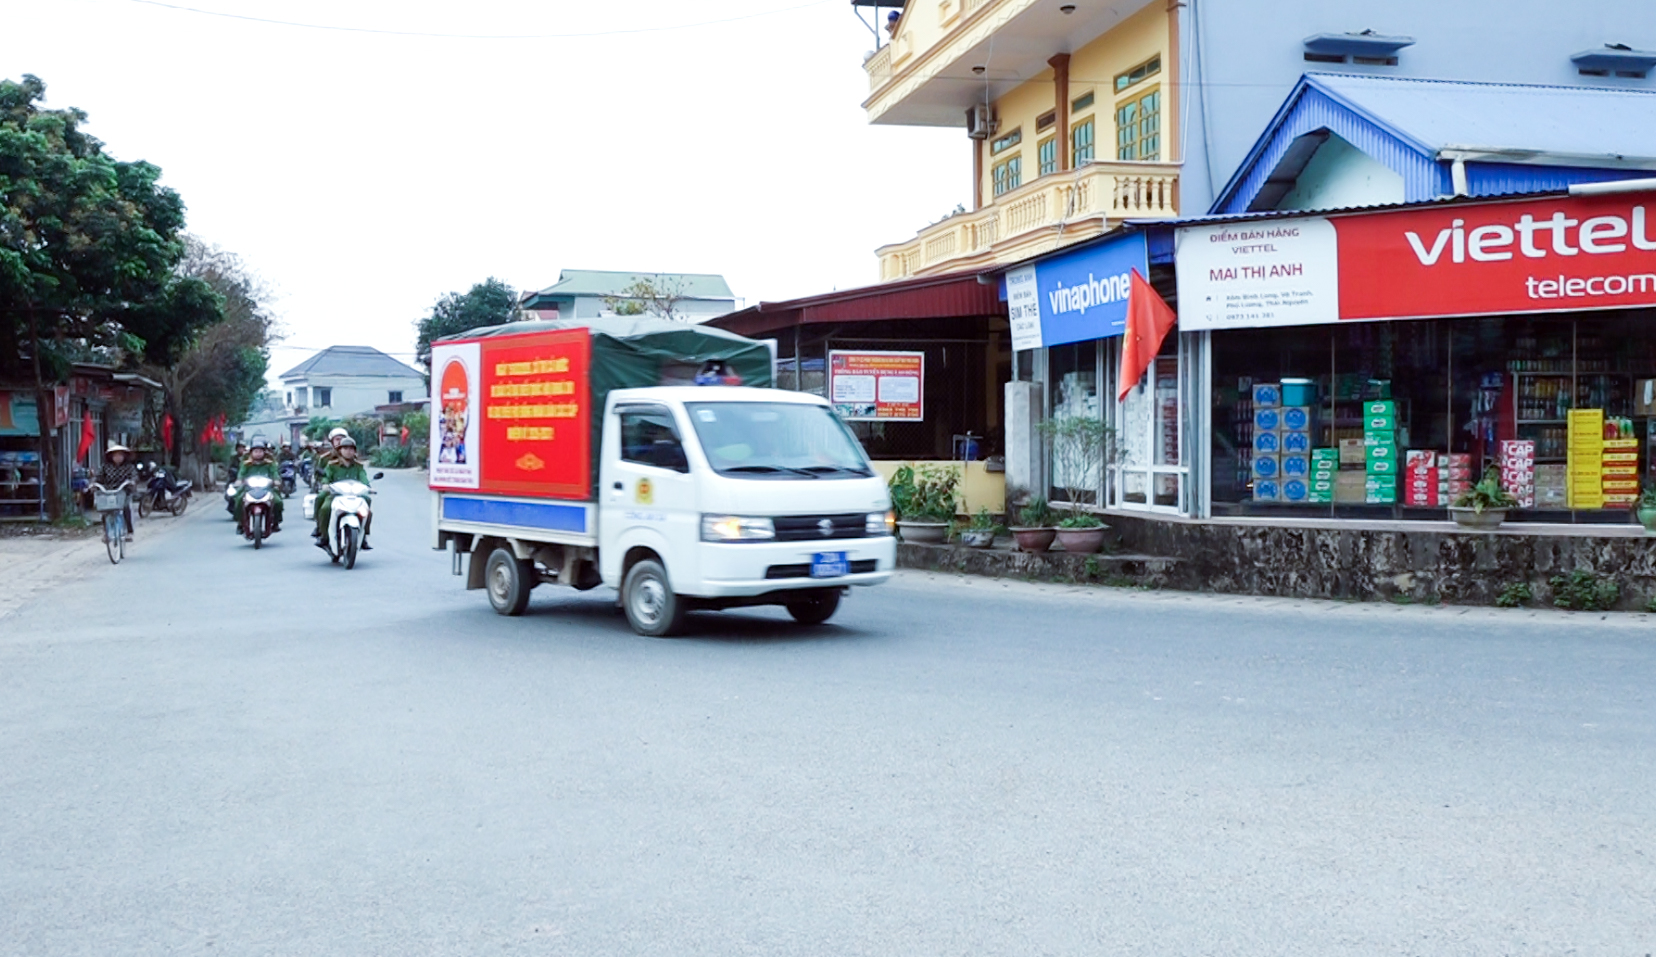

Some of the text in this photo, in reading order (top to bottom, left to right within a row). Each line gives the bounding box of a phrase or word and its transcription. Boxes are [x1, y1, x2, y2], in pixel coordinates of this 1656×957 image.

[1209, 227, 1300, 242] ĐIỂM BÁN HÀNG
[1404, 206, 1656, 266] viettel
[1231, 243, 1278, 254] VIETTEL
[1209, 263, 1303, 281] MAI THỊ ANH
[1048, 272, 1130, 315] vinaphone
[1525, 273, 1656, 298] telecom
